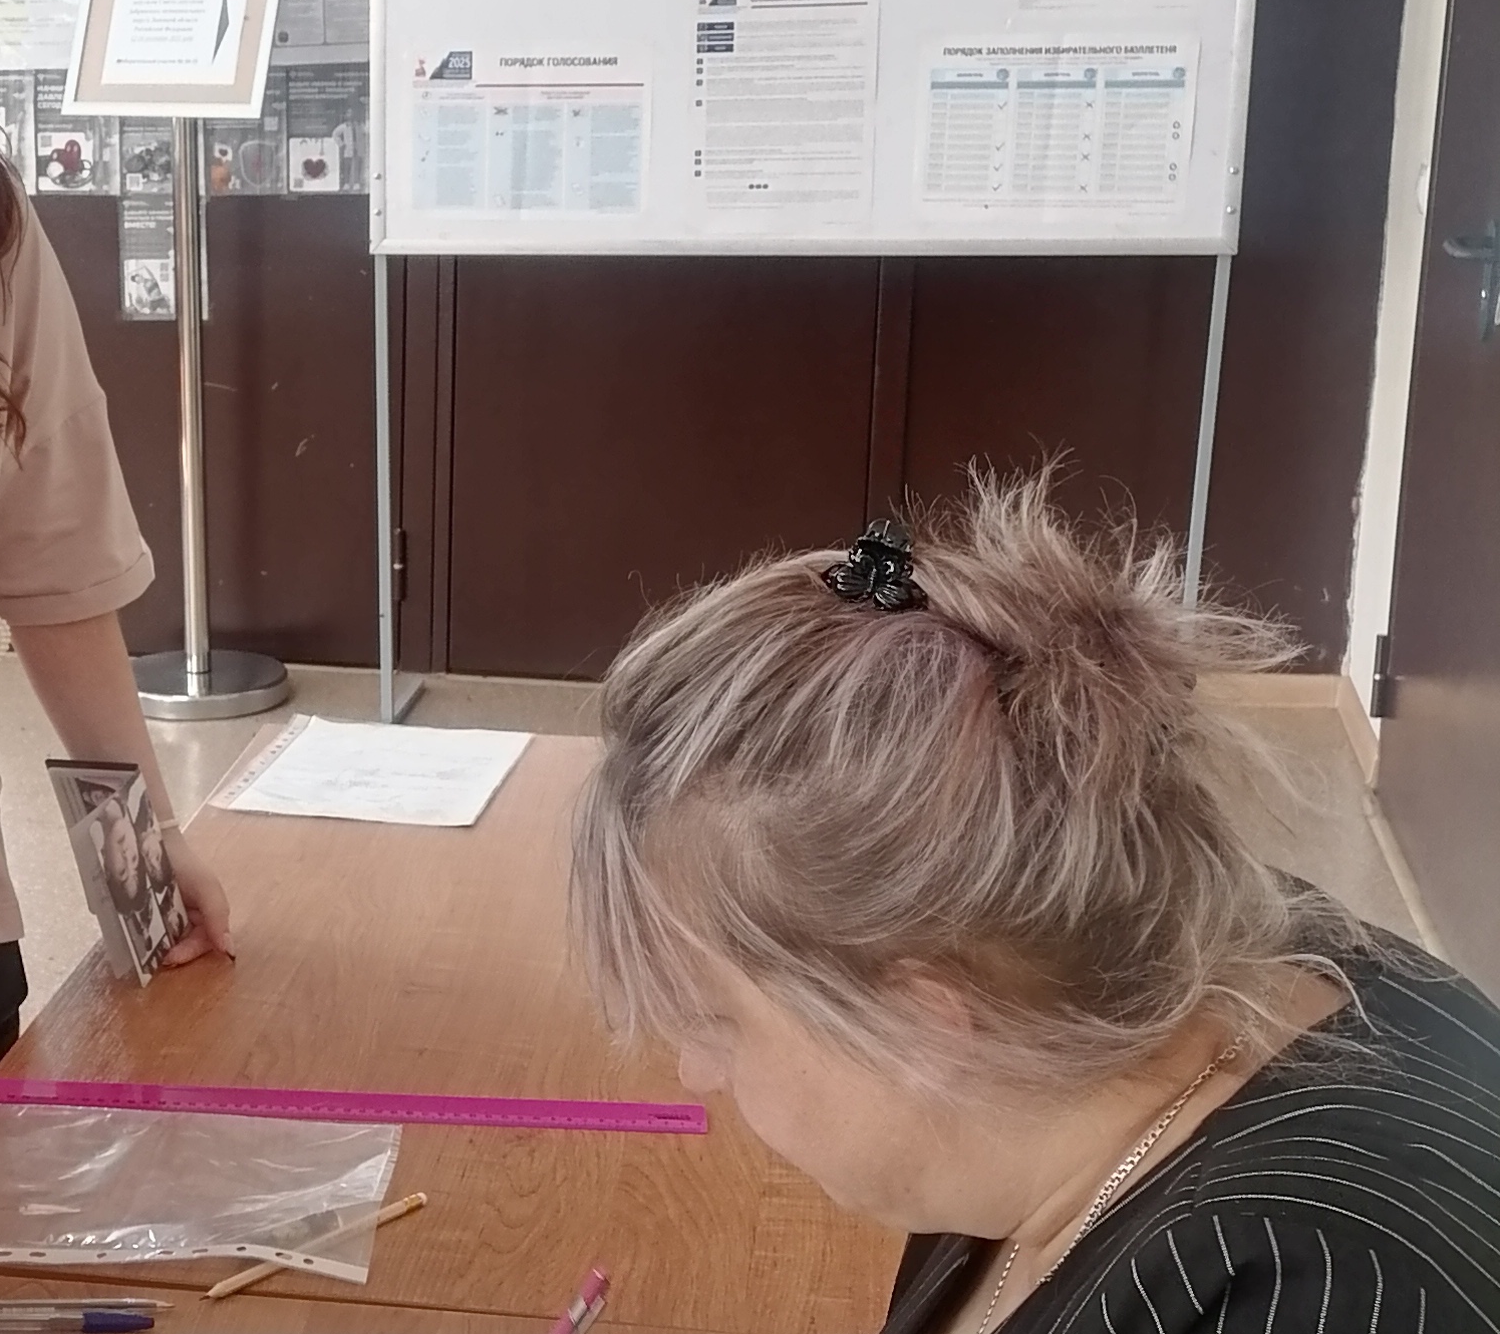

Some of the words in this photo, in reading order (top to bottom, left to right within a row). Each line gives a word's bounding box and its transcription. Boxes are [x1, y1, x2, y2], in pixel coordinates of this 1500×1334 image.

[943, 47, 983, 56] ПОРЯДОК
[985, 46, 1043, 56] ЗАПОЛНЕНИЯ
[1044, 45, 1122, 55] ИЗБИРАТЕЛЬНОГО
[500, 57, 545, 68] ПОРЯДОК
[547, 56, 618, 67] ГОЛОСОВАНИЯ
